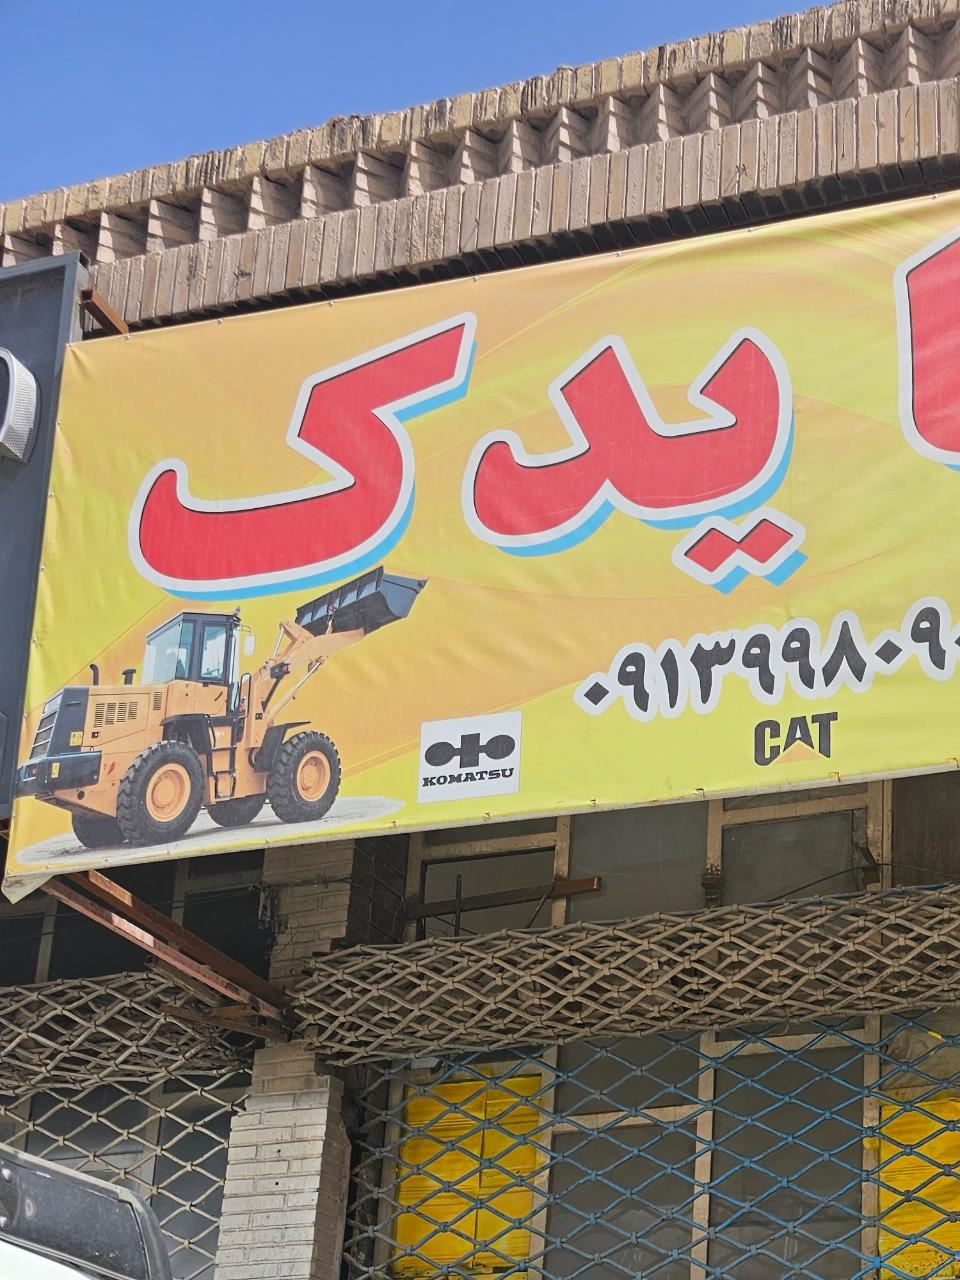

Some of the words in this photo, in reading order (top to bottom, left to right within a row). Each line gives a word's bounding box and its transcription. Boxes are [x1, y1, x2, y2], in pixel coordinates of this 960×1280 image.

[130, 312, 806, 593] یدک
[754, 712, 838, 766] CAT
[422, 768, 514, 787] KOMATSU
